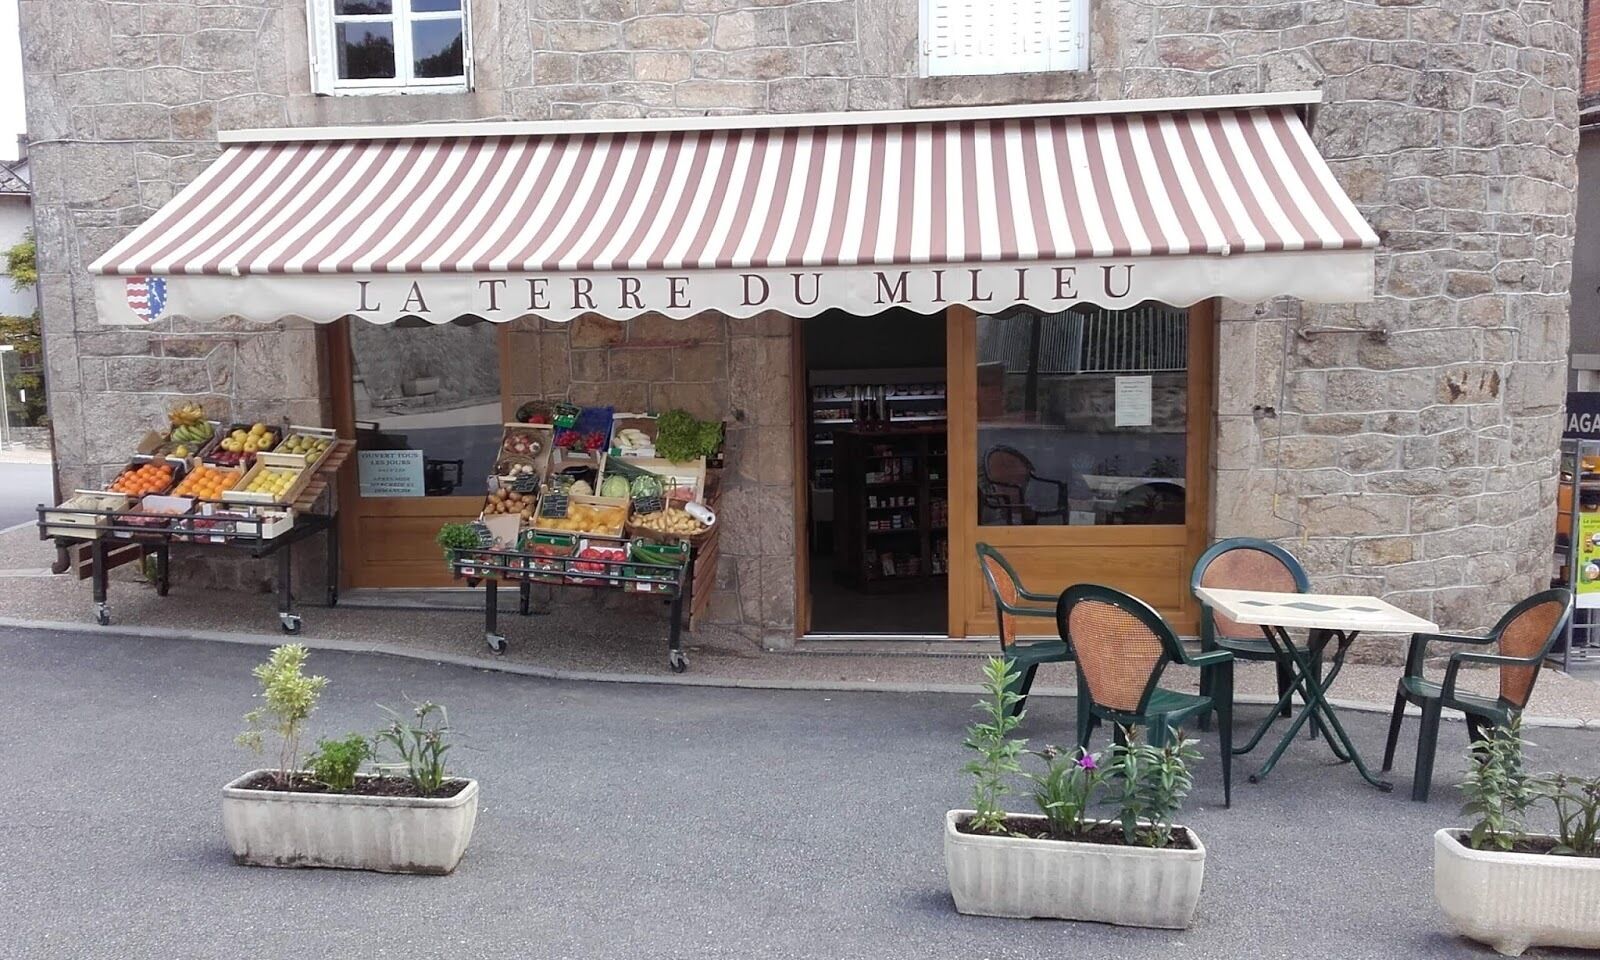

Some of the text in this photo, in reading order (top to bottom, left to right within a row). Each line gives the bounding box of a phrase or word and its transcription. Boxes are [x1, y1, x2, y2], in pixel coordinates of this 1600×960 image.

[356, 264, 1135, 313] LA TERRE DU MILIEU
